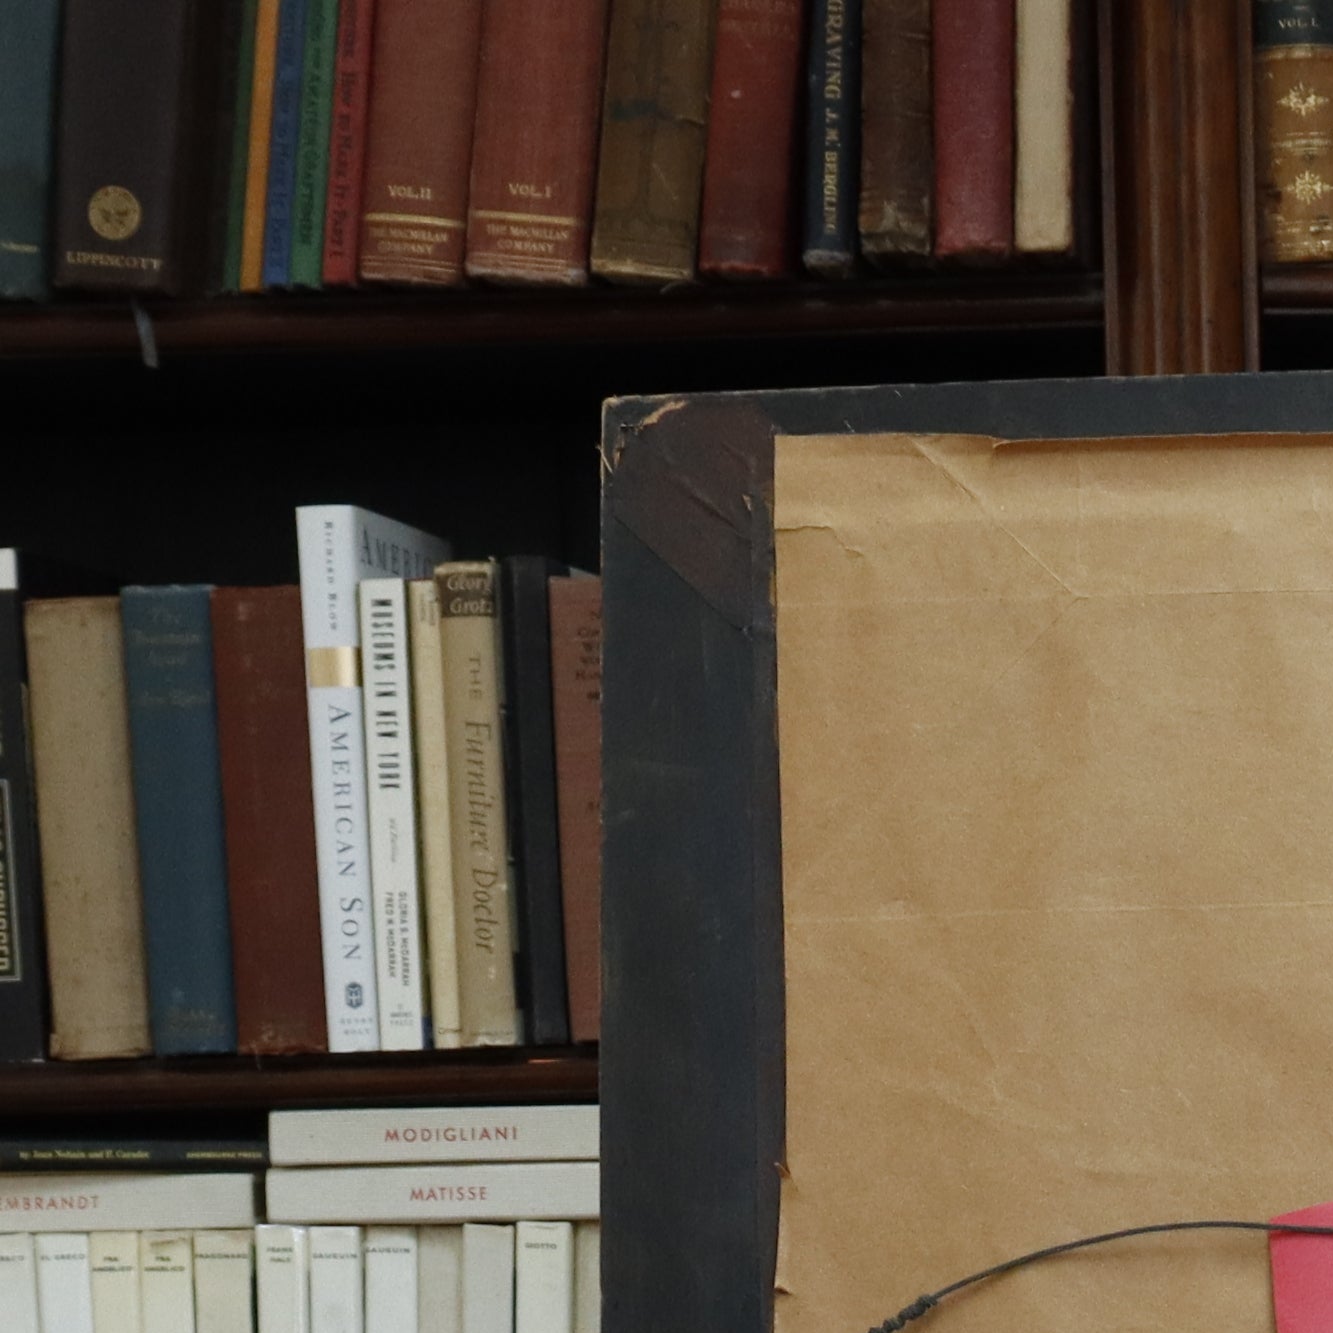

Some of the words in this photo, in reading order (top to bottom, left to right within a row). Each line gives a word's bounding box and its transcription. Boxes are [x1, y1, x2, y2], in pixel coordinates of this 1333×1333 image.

[324, 520, 338, 585] RICHARD
[370, 598, 396, 671] MUSEUMS
[372, 680, 397, 699] IN
[467, 655, 485, 700] THE
[375, 709, 399, 742] NEW
[327, 702, 358, 878] AMERICAN
[376, 752, 401, 791] YORK
[464, 718, 497, 852] Furniture
[384, 890, 396, 916] FRED
[470, 867, 500, 955] Doctor
[338, 895, 363, 961] SON
[384, 1125, 519, 1143] MODIGLIANI
[409, 1186, 488, 1201] MATISSE
[524, 1241, 558, 1250] GIOTTO
